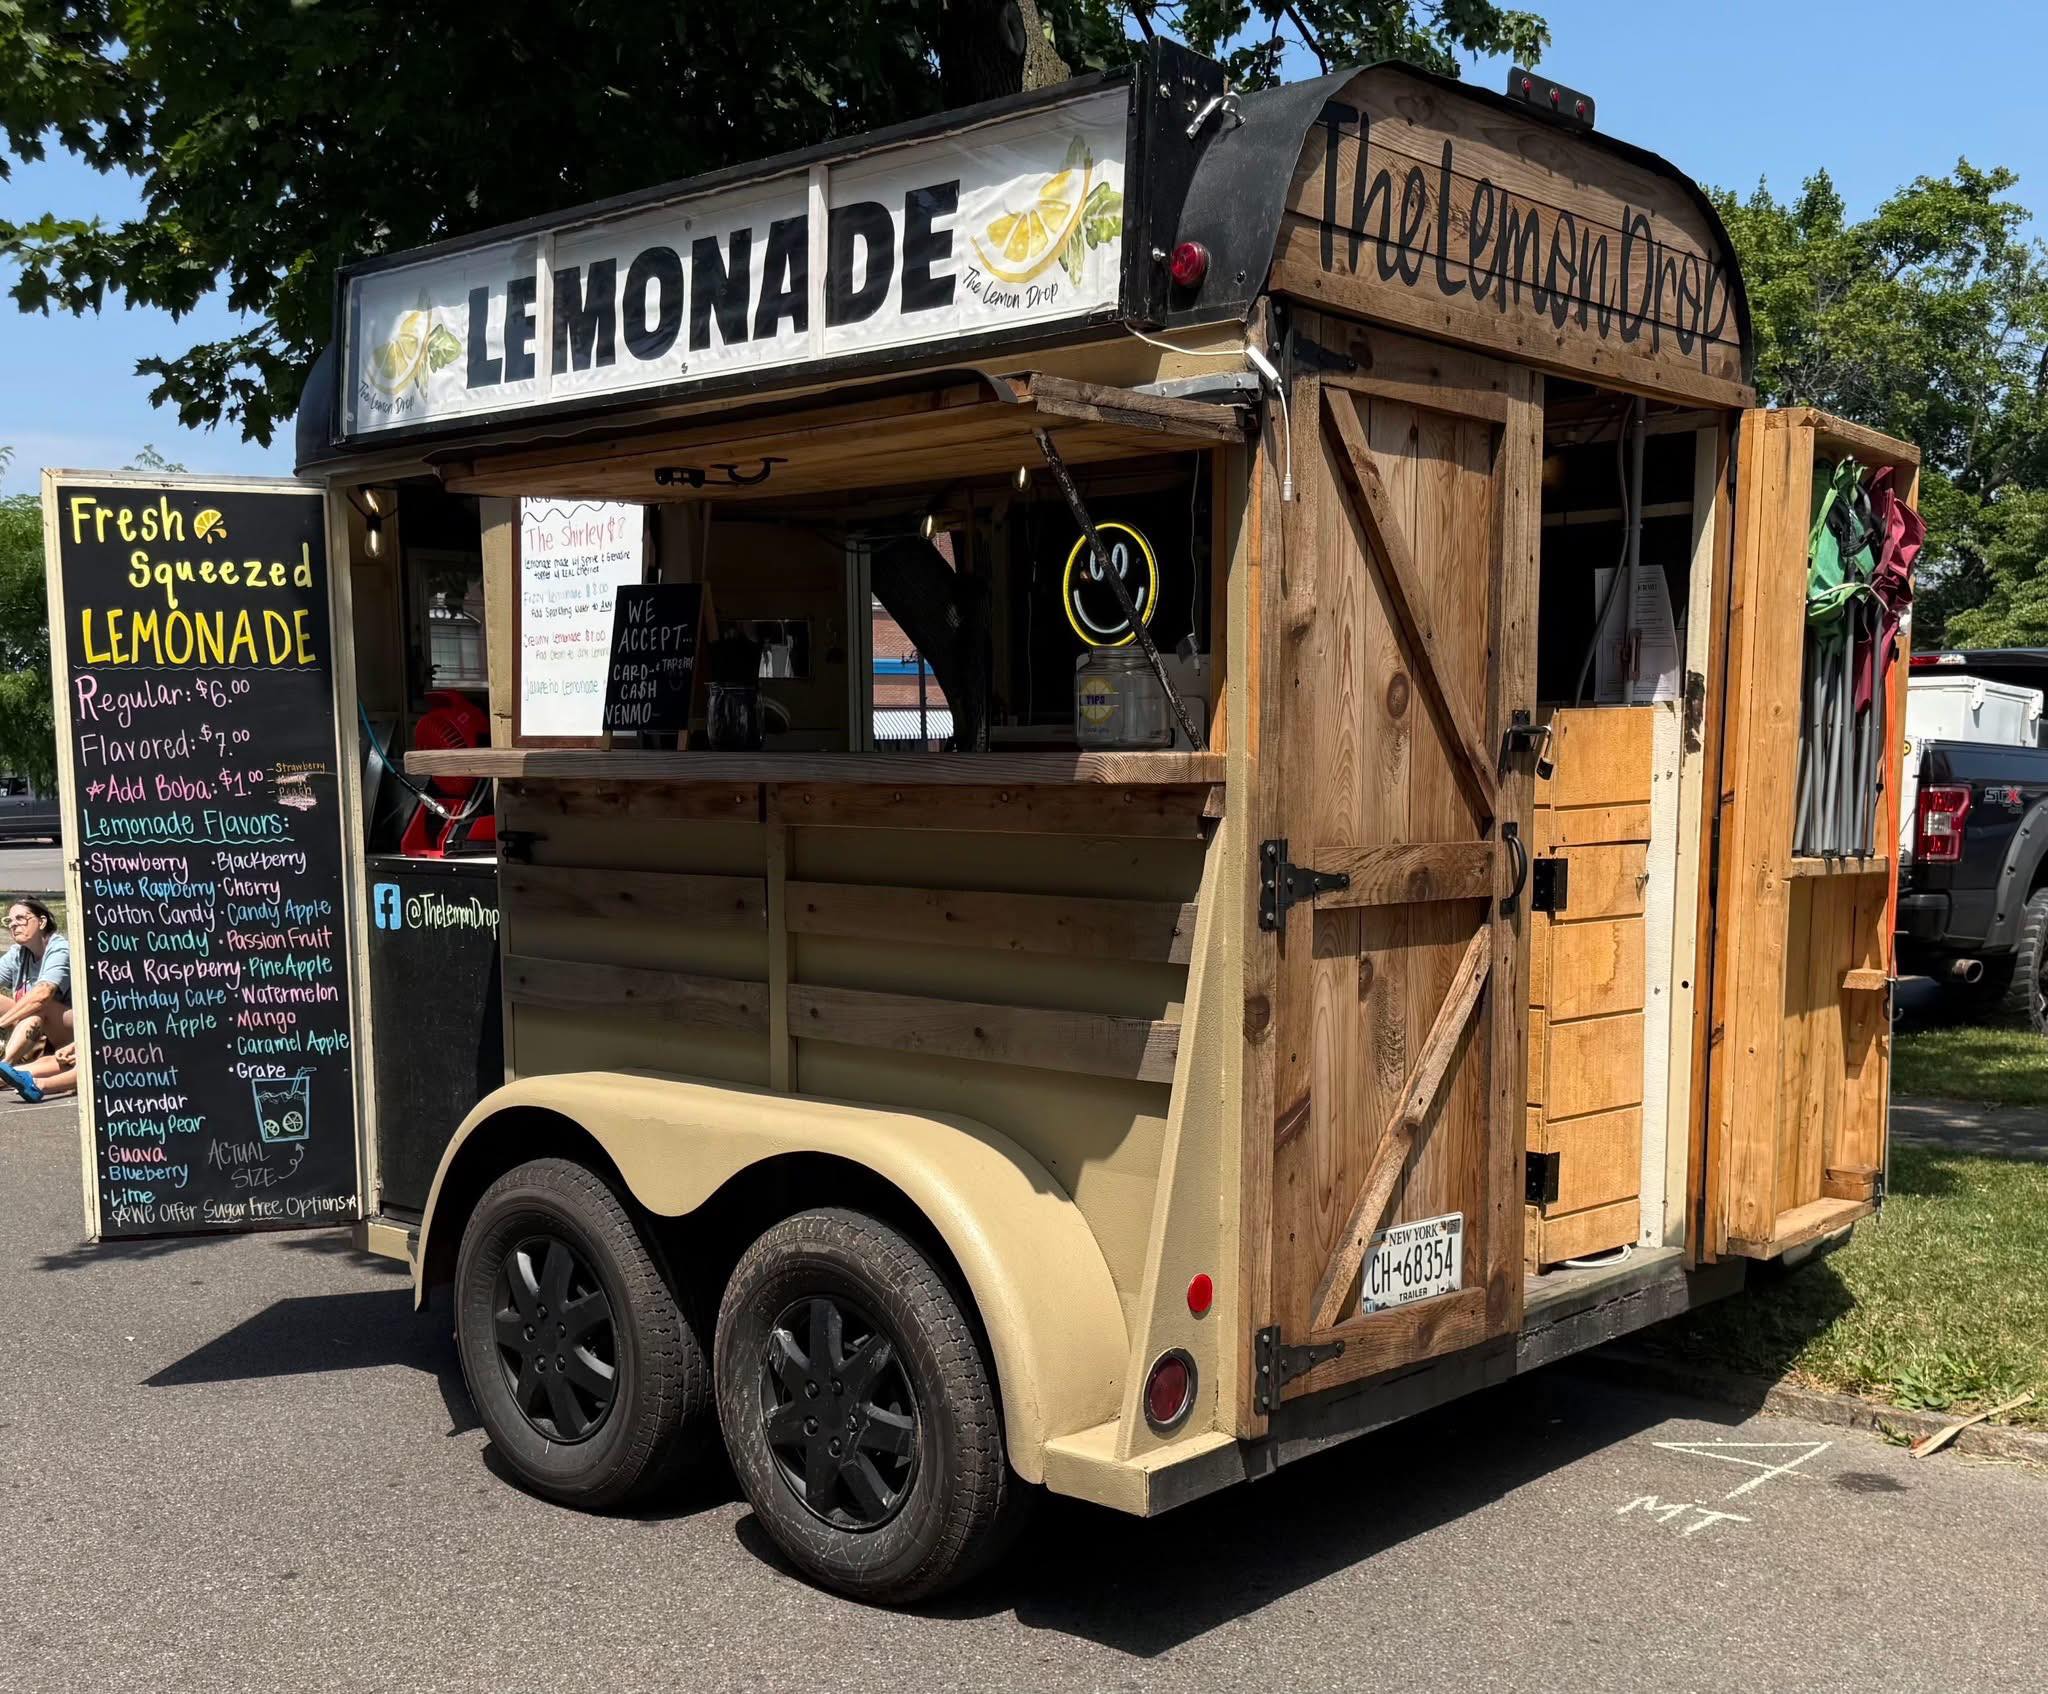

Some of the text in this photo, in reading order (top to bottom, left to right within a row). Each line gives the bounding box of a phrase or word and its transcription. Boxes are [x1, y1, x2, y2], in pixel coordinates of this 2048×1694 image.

[1316, 101, 1730, 375] The Lemon Drop
[467, 180, 961, 389] LEMONADE
[963, 266, 1059, 309] The Lemon Drop
[71, 496, 185, 544] Fresh
[525, 526, 554, 553] The
[561, 522, 604, 548] Shirley
[128, 542, 313, 609] Squeezed
[627, 598, 656, 624] WE
[82, 607, 317, 665] LEMONADE
[75, 674, 192, 728] Regular:
[1087, 695, 1105, 705] TIPS
[605, 702, 652, 726] VENMO
[80, 732, 196, 766] Flavored:
[276, 762, 326, 774] Strawberry
[107, 776, 147, 803] Add
[154, 775, 219, 801] Boba:
[1984, 784, 2023, 808] STX
[84, 808, 290, 841] Lemonade Flavors:
[91, 853, 188, 883] Strawberry
[216, 852, 306, 875] Blackberry
[94, 877, 216, 907] Blue Raspberry
[222, 878, 280, 905] Cherry
[95, 903, 215, 932] Cotton Candy
[227, 899, 332, 929] Candy Apple
[406, 894, 499, 940] @TheLemonDrop
[97, 930, 210, 957] Sour Candy
[227, 926, 333, 951] Passion Fruit
[97, 958, 241, 990] Red Raspberry
[101, 988, 227, 1014] Birthday Cake
[242, 982, 339, 1005] Watermelon
[101, 1012, 218, 1041] Green Apple
[237, 1009, 297, 1034] Mango
[237, 1029, 351, 1056] Caramel Apple
[103, 1065, 178, 1089] Coconut
[236, 1062, 286, 1081] Grape
[104, 1094, 188, 1117] Lavendar
[108, 1145, 168, 1165] Guava
[207, 1138, 272, 1172] ACTUAL
[109, 1163, 189, 1189] Blueberry
[230, 1166, 277, 1190] SIZE
[110, 1186, 156, 1208] Lime
[159, 1201, 198, 1224] Offer
[203, 1196, 246, 1222] Sugar
[249, 1193, 283, 1216] Free
[286, 1192, 346, 1219] Options
[1389, 1231, 1411, 1247] NEW
[1414, 1223, 1438, 1241] YORK
[1371, 1236, 1452, 1295] CH 68354
[1399, 1287, 1428, 1302] TRAILER
